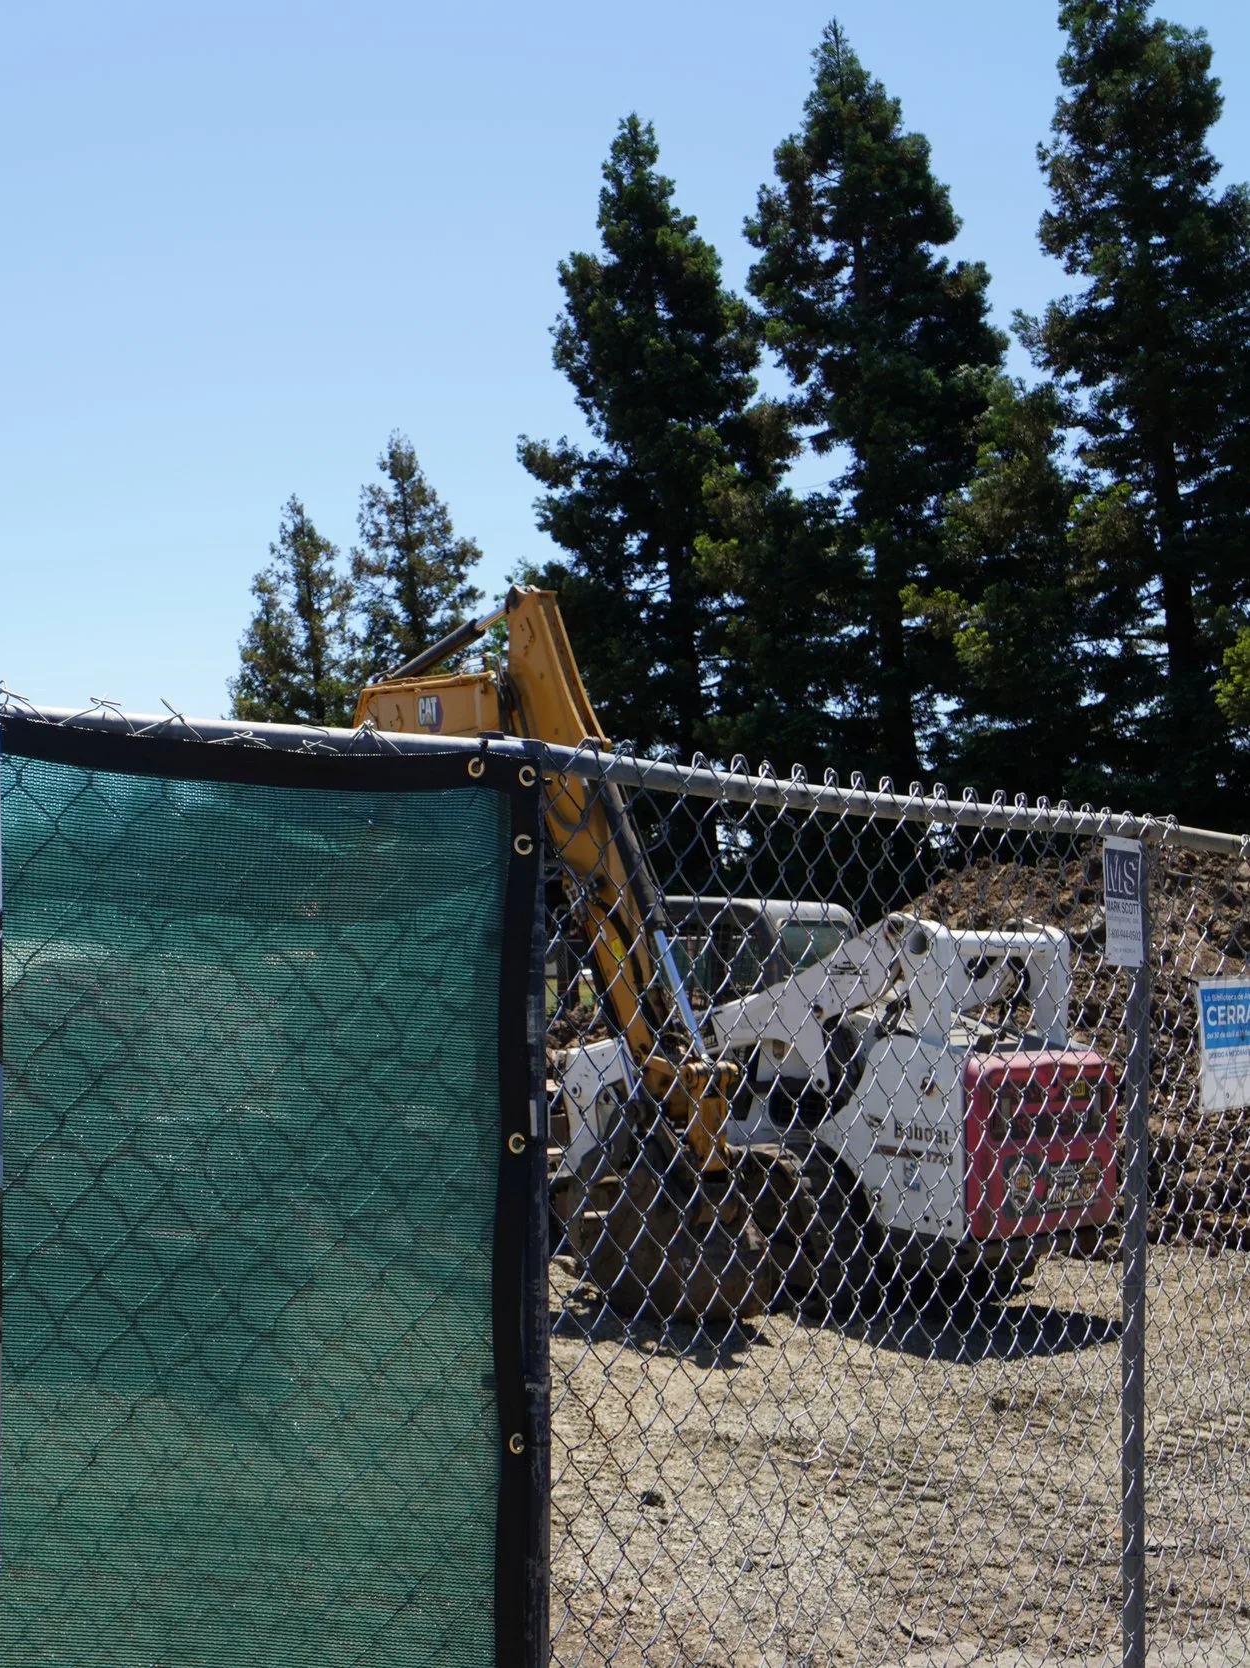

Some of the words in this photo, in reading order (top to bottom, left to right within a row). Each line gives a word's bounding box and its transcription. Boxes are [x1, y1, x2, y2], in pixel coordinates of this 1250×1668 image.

[419, 697, 437, 725] CAT
[1106, 853, 1138, 896] MS
[1106, 900, 1121, 913] MARK
[1122, 902, 1139, 915] SCOTT
[894, 1119, 949, 1145] Bobcat
